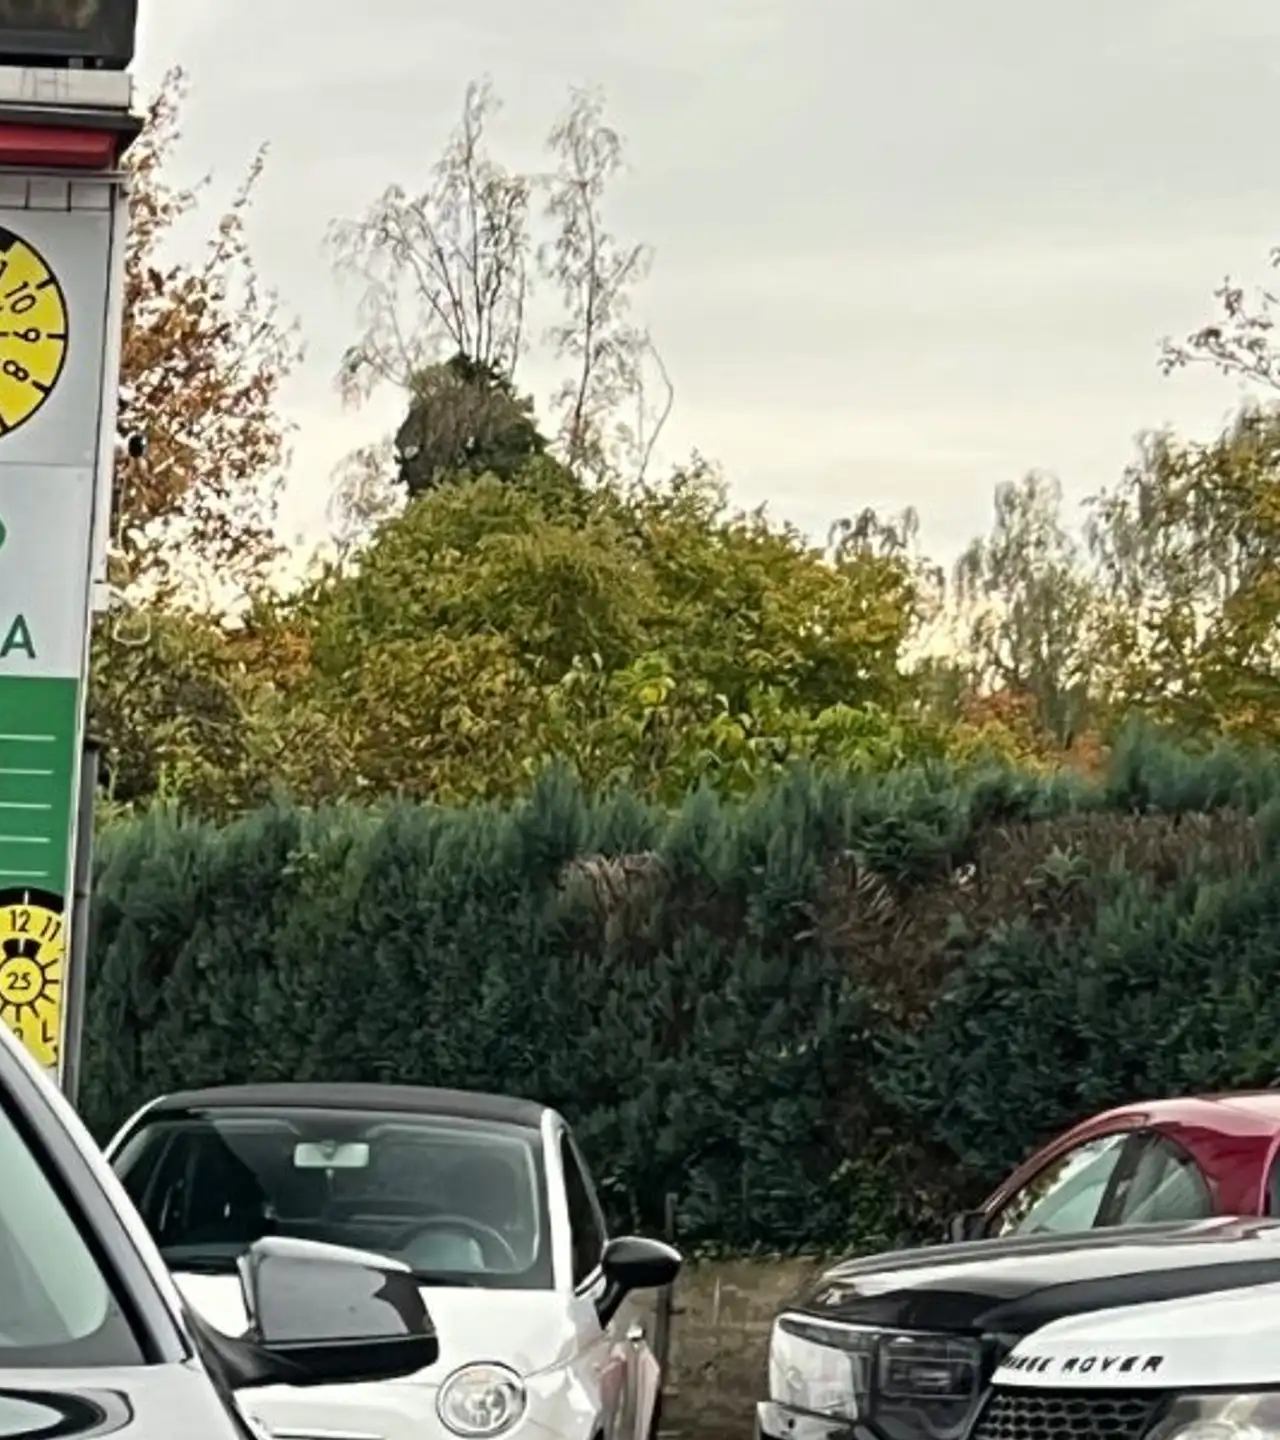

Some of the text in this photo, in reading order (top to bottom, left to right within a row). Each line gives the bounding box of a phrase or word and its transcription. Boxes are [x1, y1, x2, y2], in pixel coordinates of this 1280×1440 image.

[4, 281, 36, 314] 10
[12, 328, 41, 343] 9
[2, 360, 30, 382] 8
[10, 909, 31, 933] 12
[40, 916, 61, 942] 11
[6, 972, 31, 990] 25
[1061, 1355, 1164, 1373] ROVER
